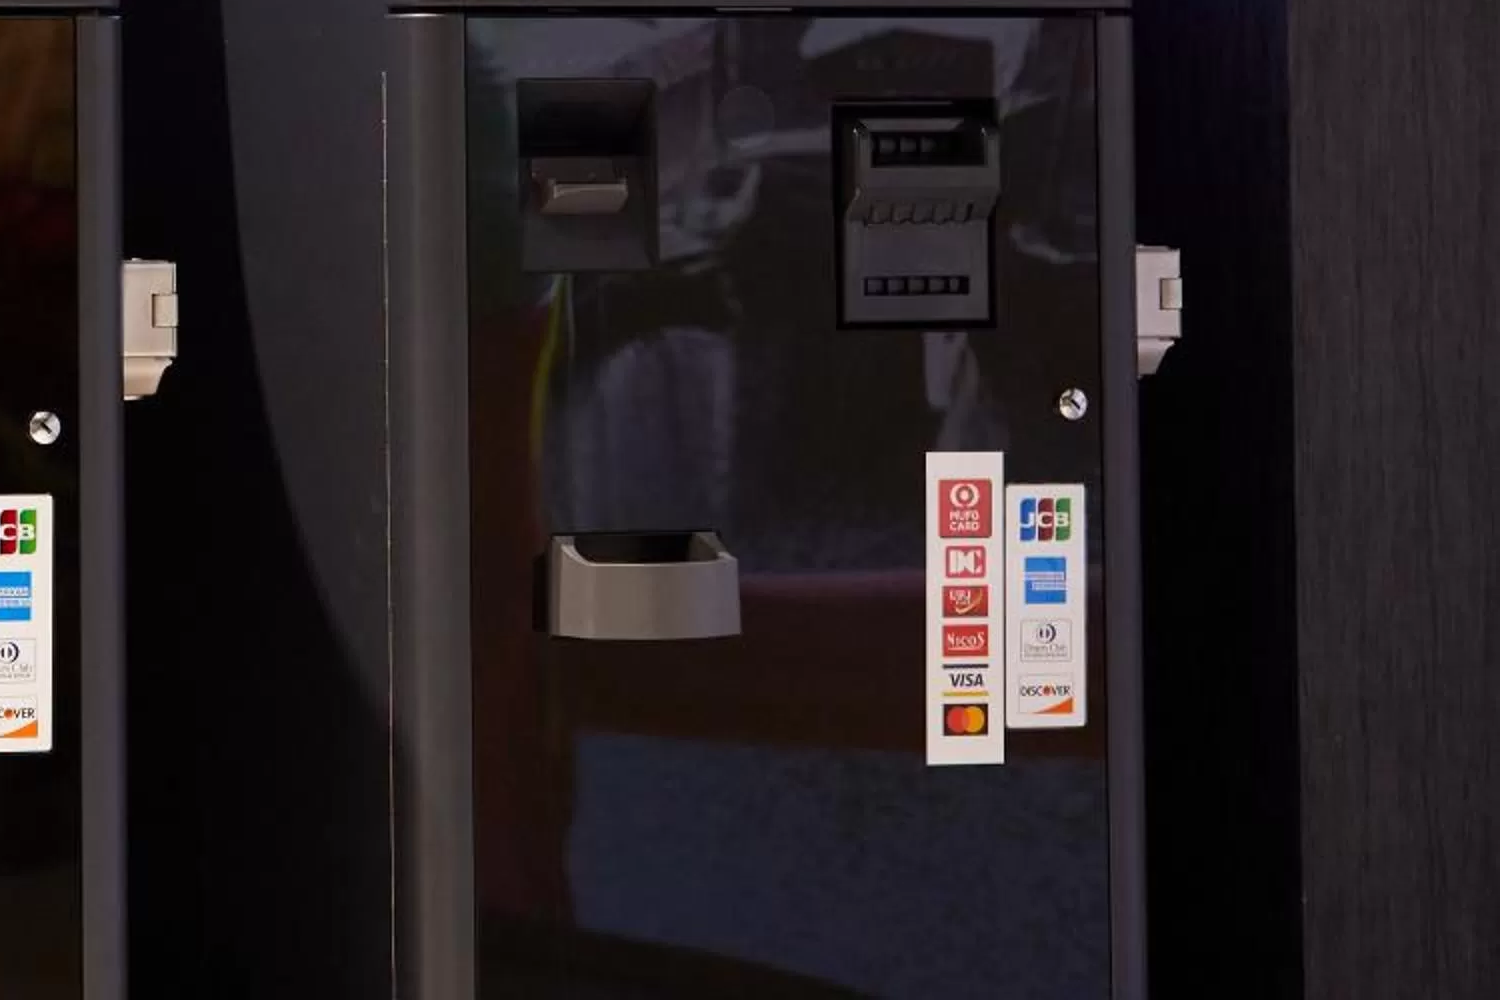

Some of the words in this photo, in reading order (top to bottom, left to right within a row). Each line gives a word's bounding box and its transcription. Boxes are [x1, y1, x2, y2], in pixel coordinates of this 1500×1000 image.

[1020, 512, 1069, 526] JCB
[950, 674, 984, 686] VISA
[1021, 685, 1070, 697] DISCOVER
